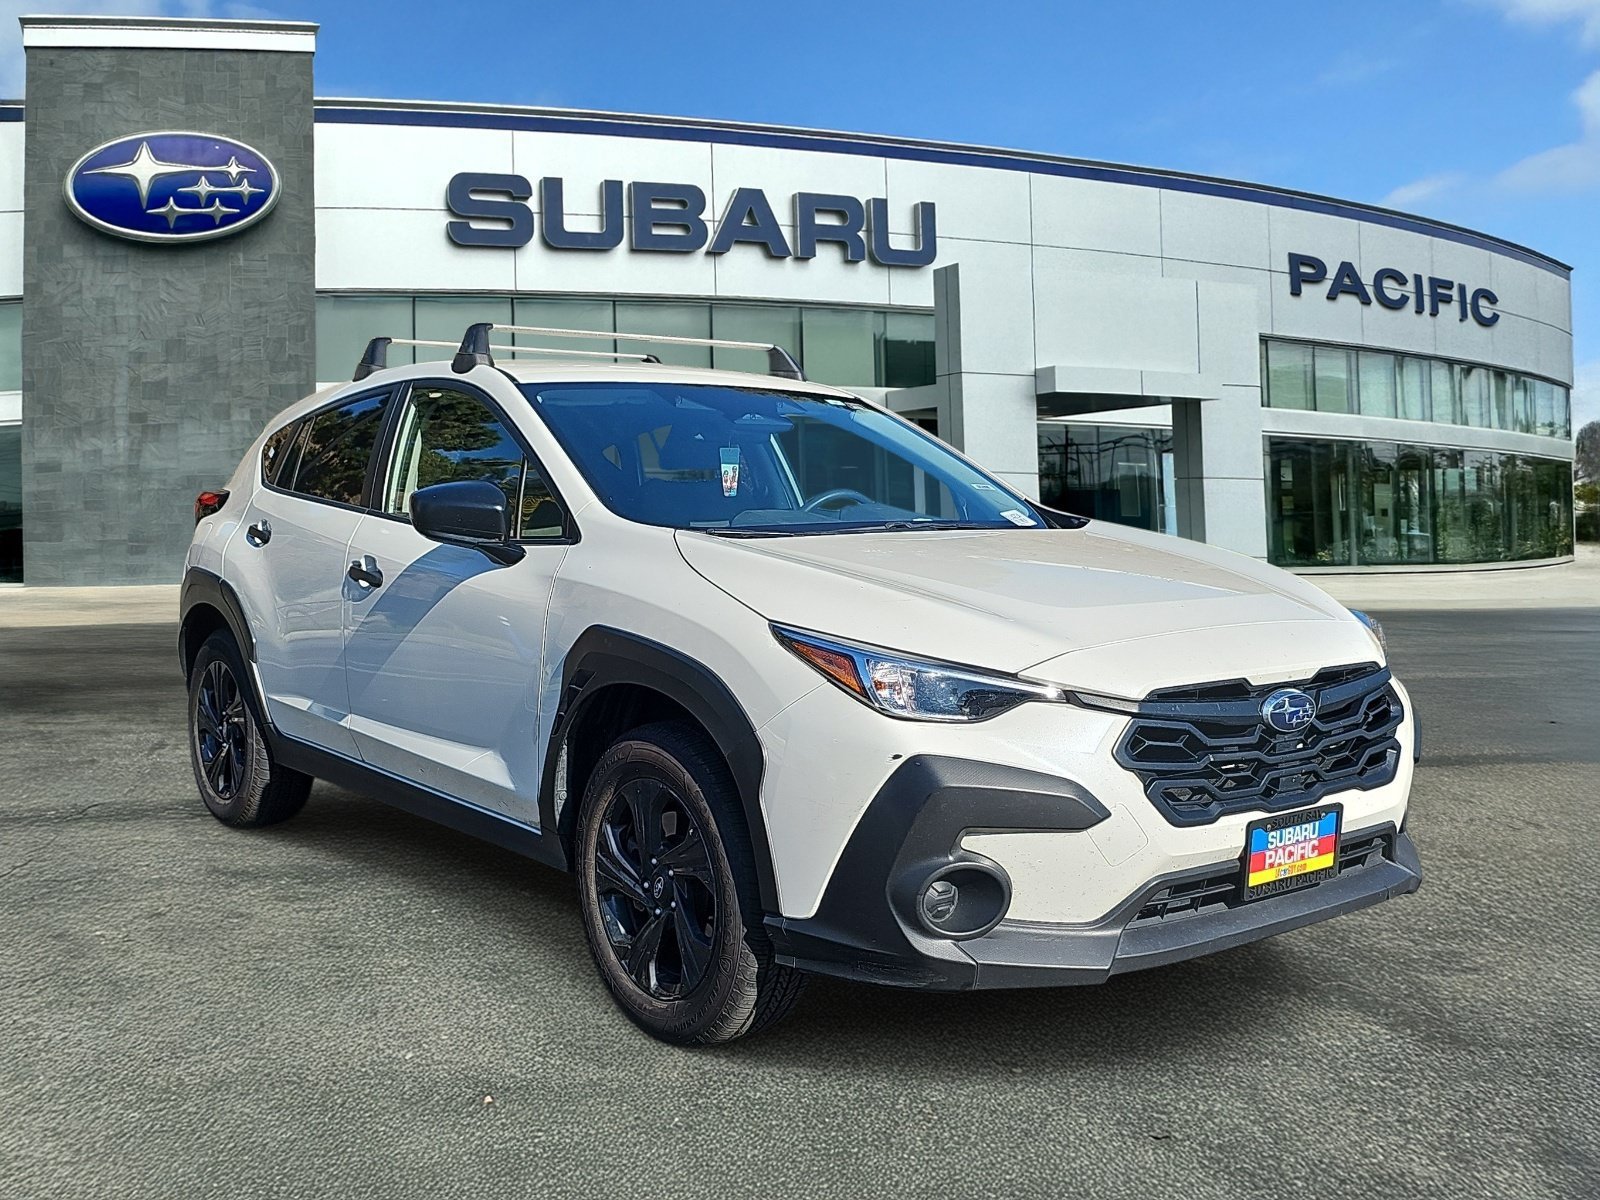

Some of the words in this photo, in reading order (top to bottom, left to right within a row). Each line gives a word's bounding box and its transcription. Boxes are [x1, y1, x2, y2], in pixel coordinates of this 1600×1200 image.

[447, 171, 937, 267] SUBARU
[1288, 252, 1500, 327] PACIFIC
[1268, 821, 1319, 849] SUBARU
[1272, 812, 1304, 828] SOUTH
[1264, 840, 1319, 869] PACIFIC
[1249, 877, 1293, 899] SUBARU
[1296, 868, 1338, 886] PACIFIC
